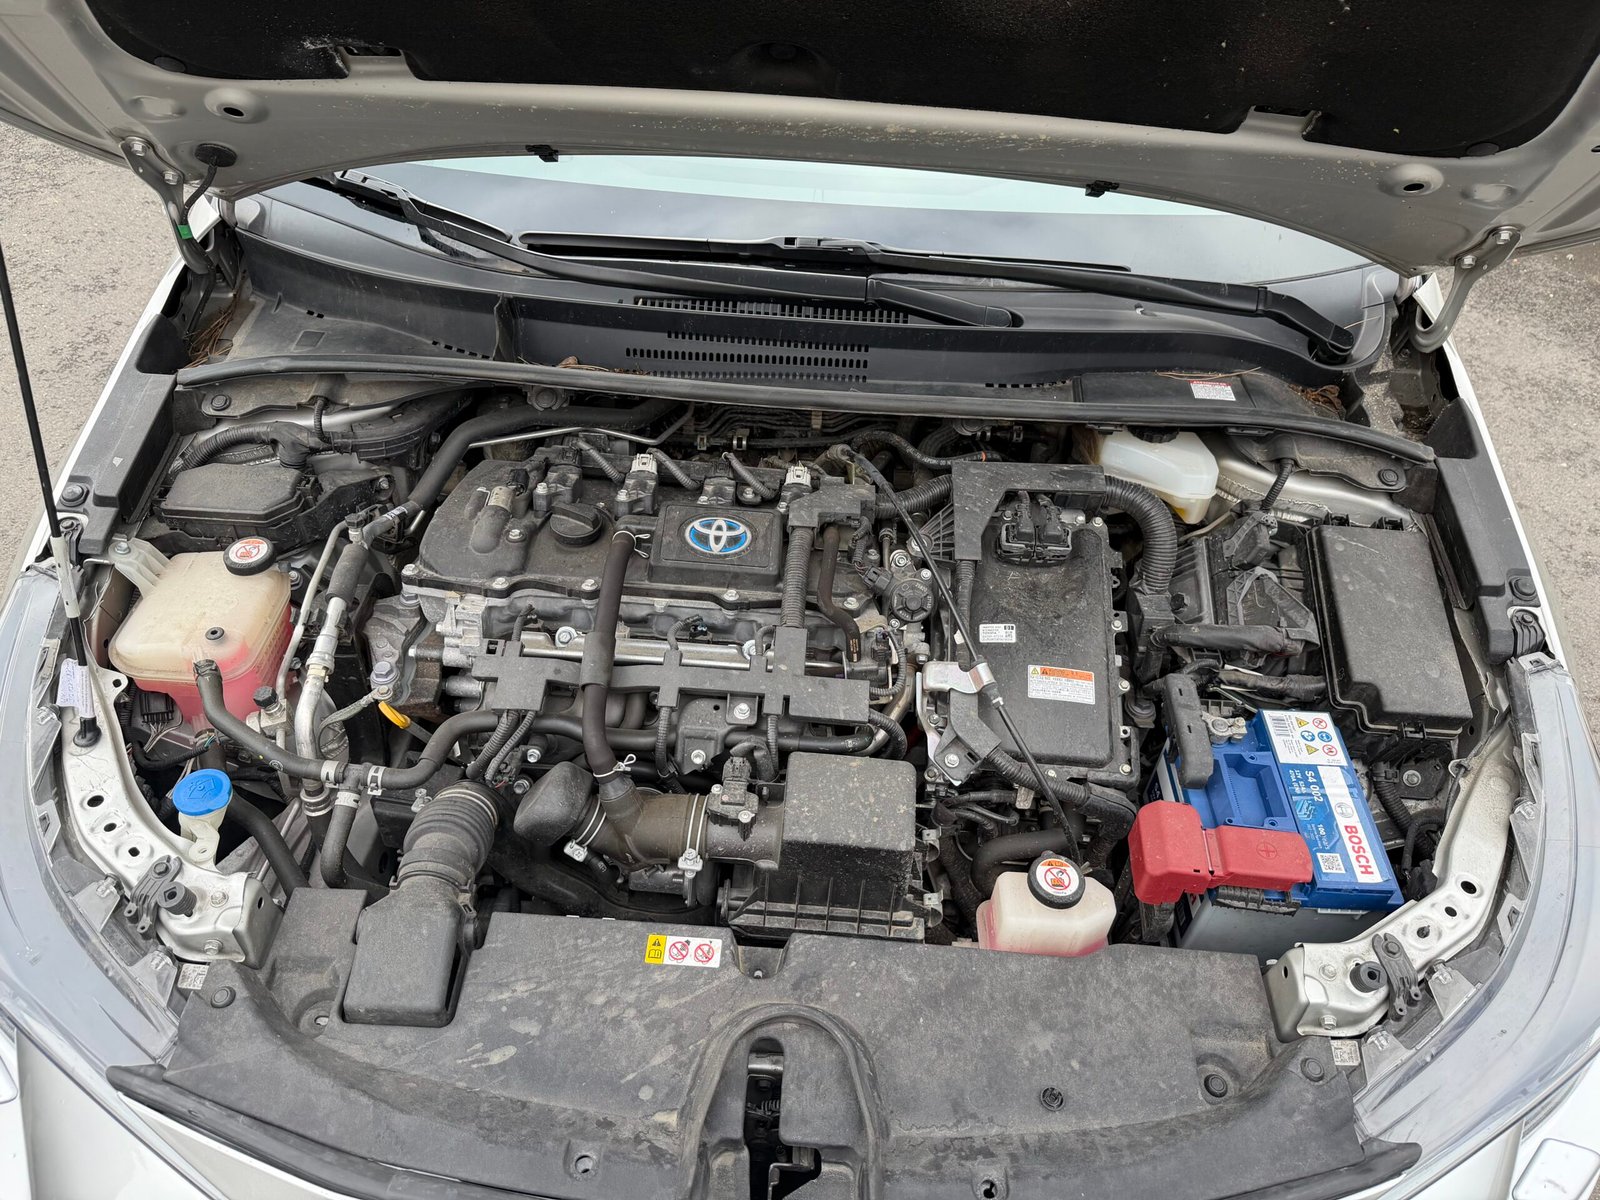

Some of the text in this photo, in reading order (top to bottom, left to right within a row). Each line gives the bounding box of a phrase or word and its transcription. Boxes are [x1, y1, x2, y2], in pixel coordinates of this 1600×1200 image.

[1305, 770, 1323, 802] S4 002
[1344, 825, 1374, 875] BOSCH
